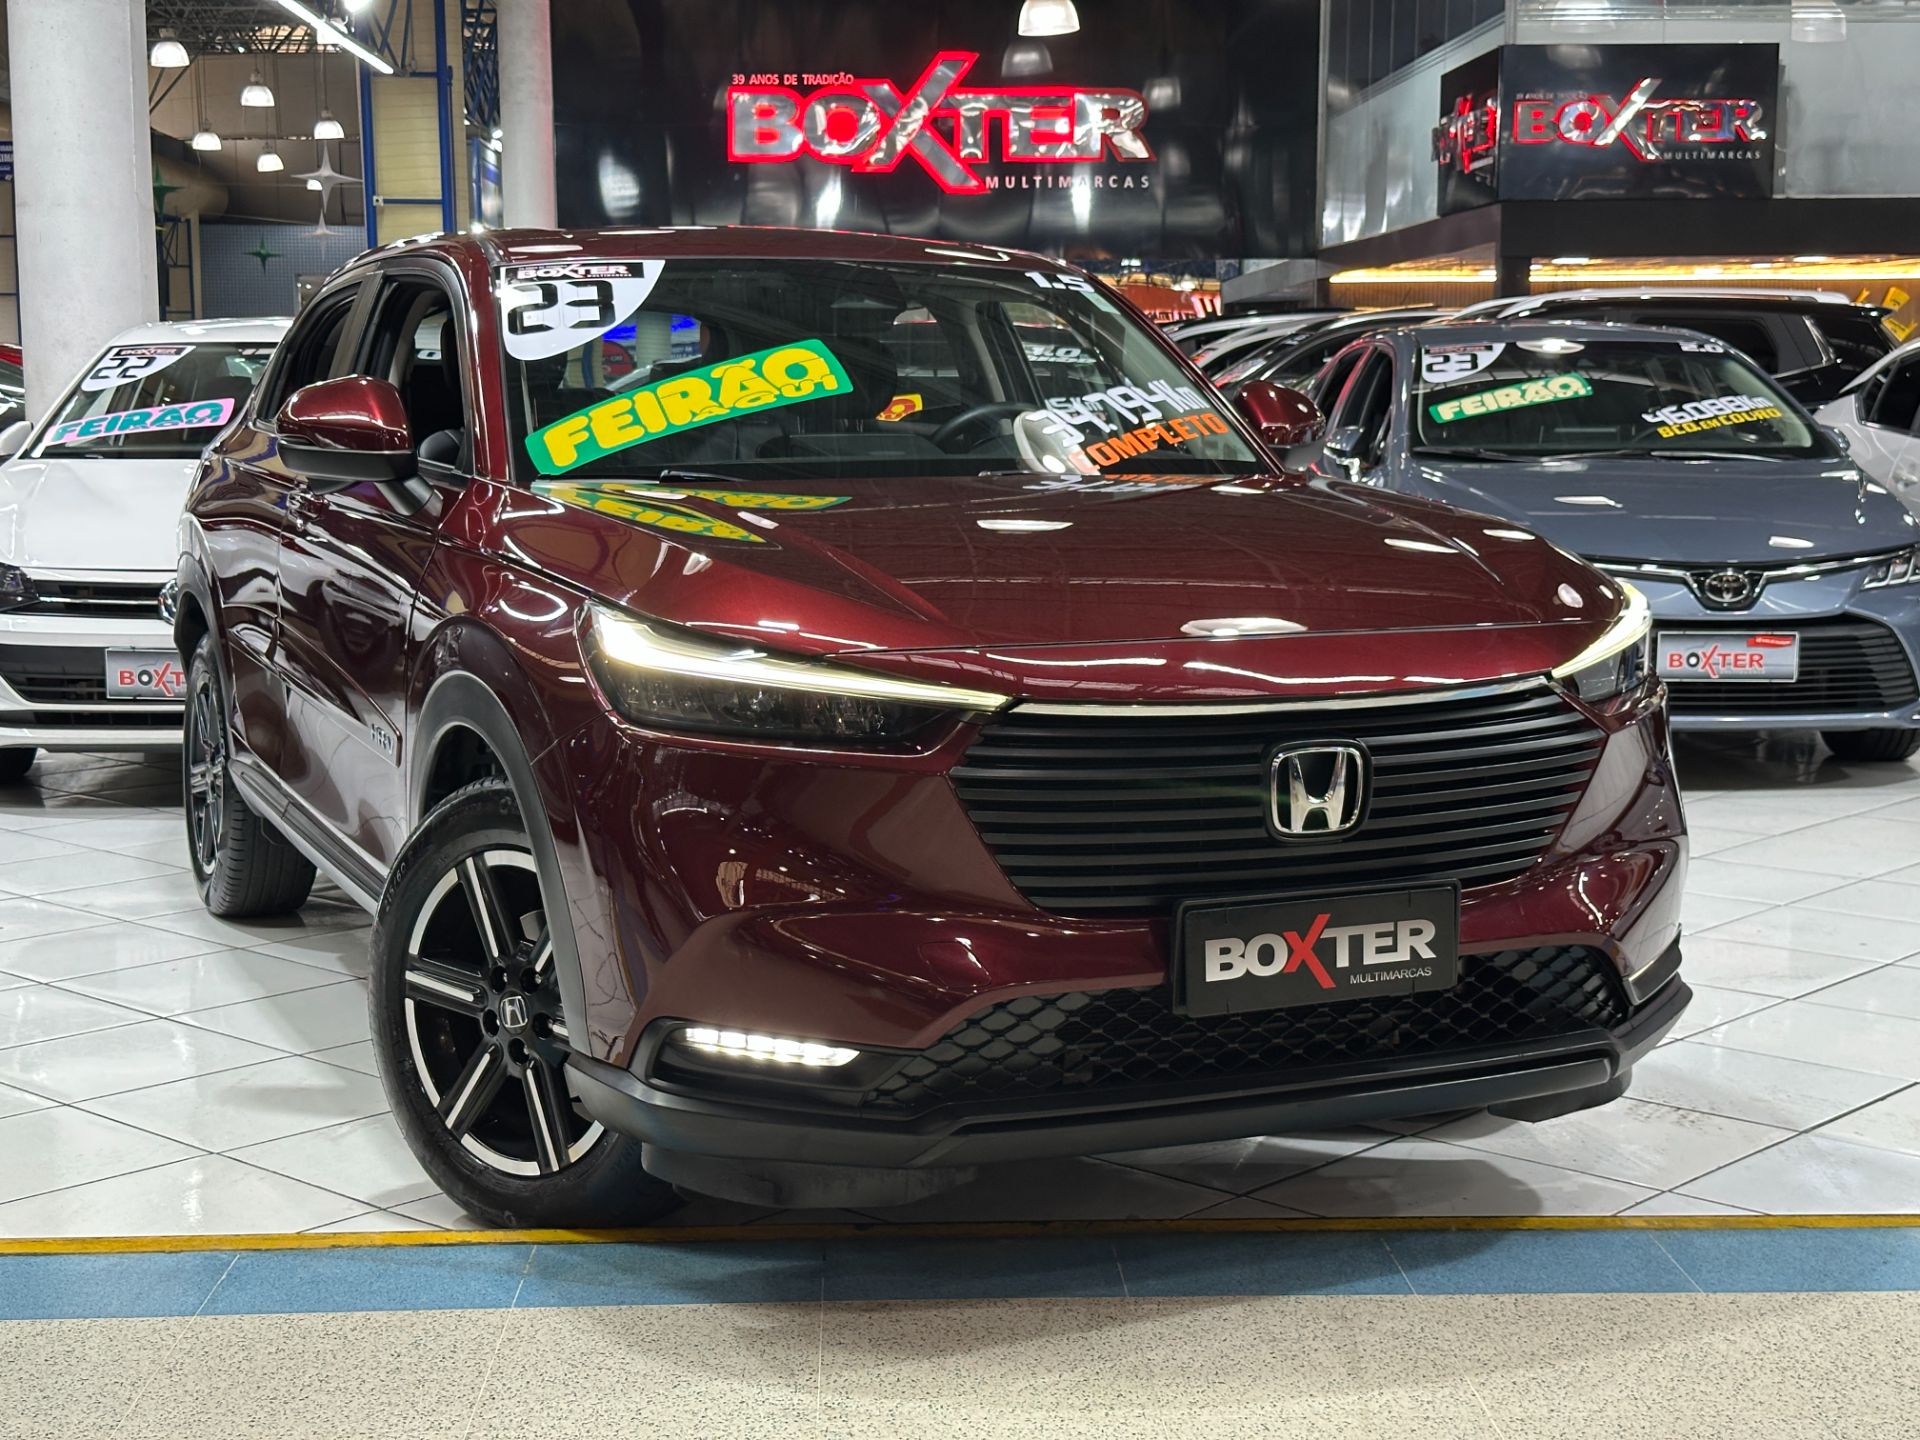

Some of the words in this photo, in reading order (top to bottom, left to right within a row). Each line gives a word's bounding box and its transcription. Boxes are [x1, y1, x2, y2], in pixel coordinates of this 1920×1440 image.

[732, 74, 745, 85] 39
[749, 74, 779, 85] ANOS
[784, 74, 797, 85] DE
[803, 73, 854, 86] TRADIÇÃO
[728, 51, 1156, 194] BOXTER
[1513, 77, 1766, 161] BOXTER
[1663, 151, 1761, 160] MULTIMARCAS
[986, 174, 1150, 189] MULTIMARCAS
[517, 264, 629, 279] BOXTER
[1025, 271, 1094, 293] 1.5
[508, 279, 616, 336] 23
[89, 356, 157, 379] 22
[1425, 352, 1478, 373] 23
[543, 348, 831, 467] FEIRÃO
[1437, 376, 1585, 421] FEIRÃO
[51, 402, 224, 442] FEIRÃO
[1067, 412, 1229, 475] COMPLETO
[1668, 643, 1765, 678] BOXTER
[118, 661, 186, 696] BOXT
[1205, 913, 1438, 989] BOXTER
[1350, 966, 1432, 984] MULTIMARCAS
